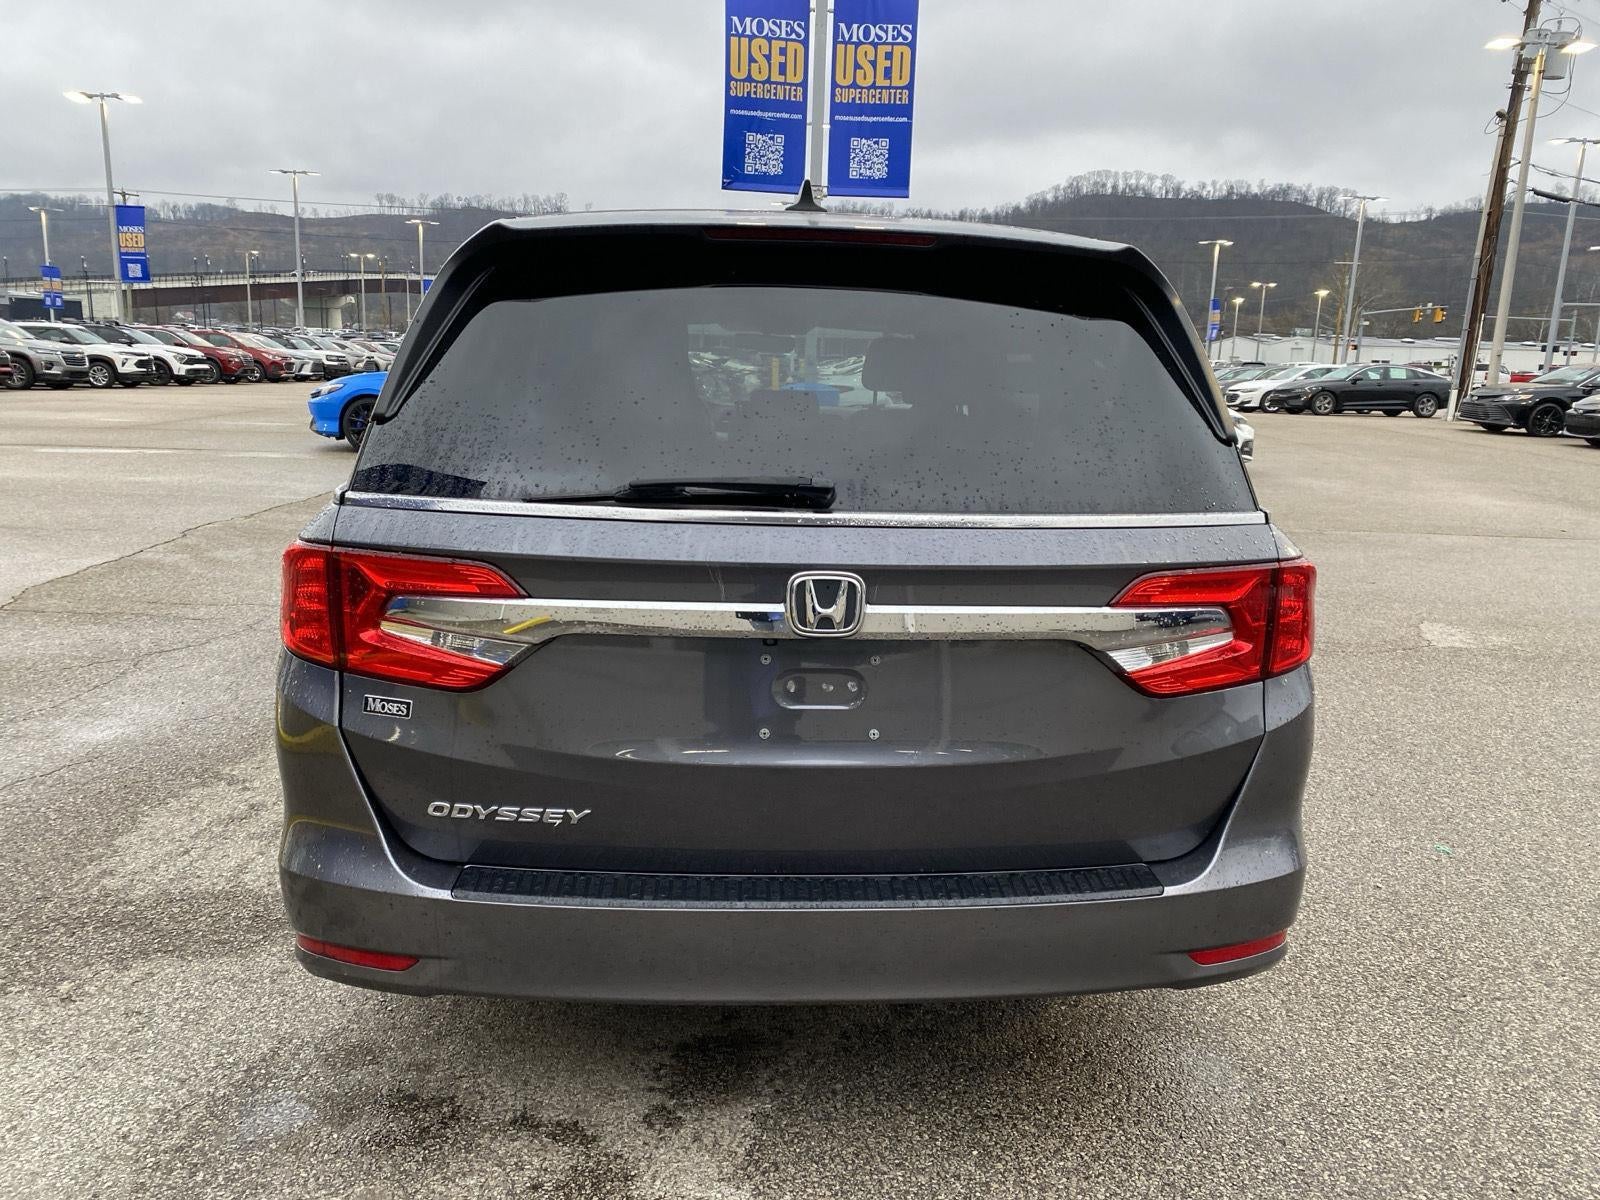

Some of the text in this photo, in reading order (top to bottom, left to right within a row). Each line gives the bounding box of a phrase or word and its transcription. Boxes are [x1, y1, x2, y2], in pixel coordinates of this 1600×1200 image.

[730, 16, 805, 40] MOSES
[837, 22, 912, 43] MOSES
[730, 36, 804, 84] USED
[835, 44, 911, 87] USED
[730, 81, 803, 102] SUPERCENTER
[835, 87, 909, 105] SUPERCENTER
[730, 109, 803, 120] mosesusedsupercenter.com
[834, 114, 908, 123] mosesusedsupercenter.com
[119, 233, 144, 247] USED
[366, 698, 407, 716] MOSES
[427, 801, 591, 826] ODYSSEY
